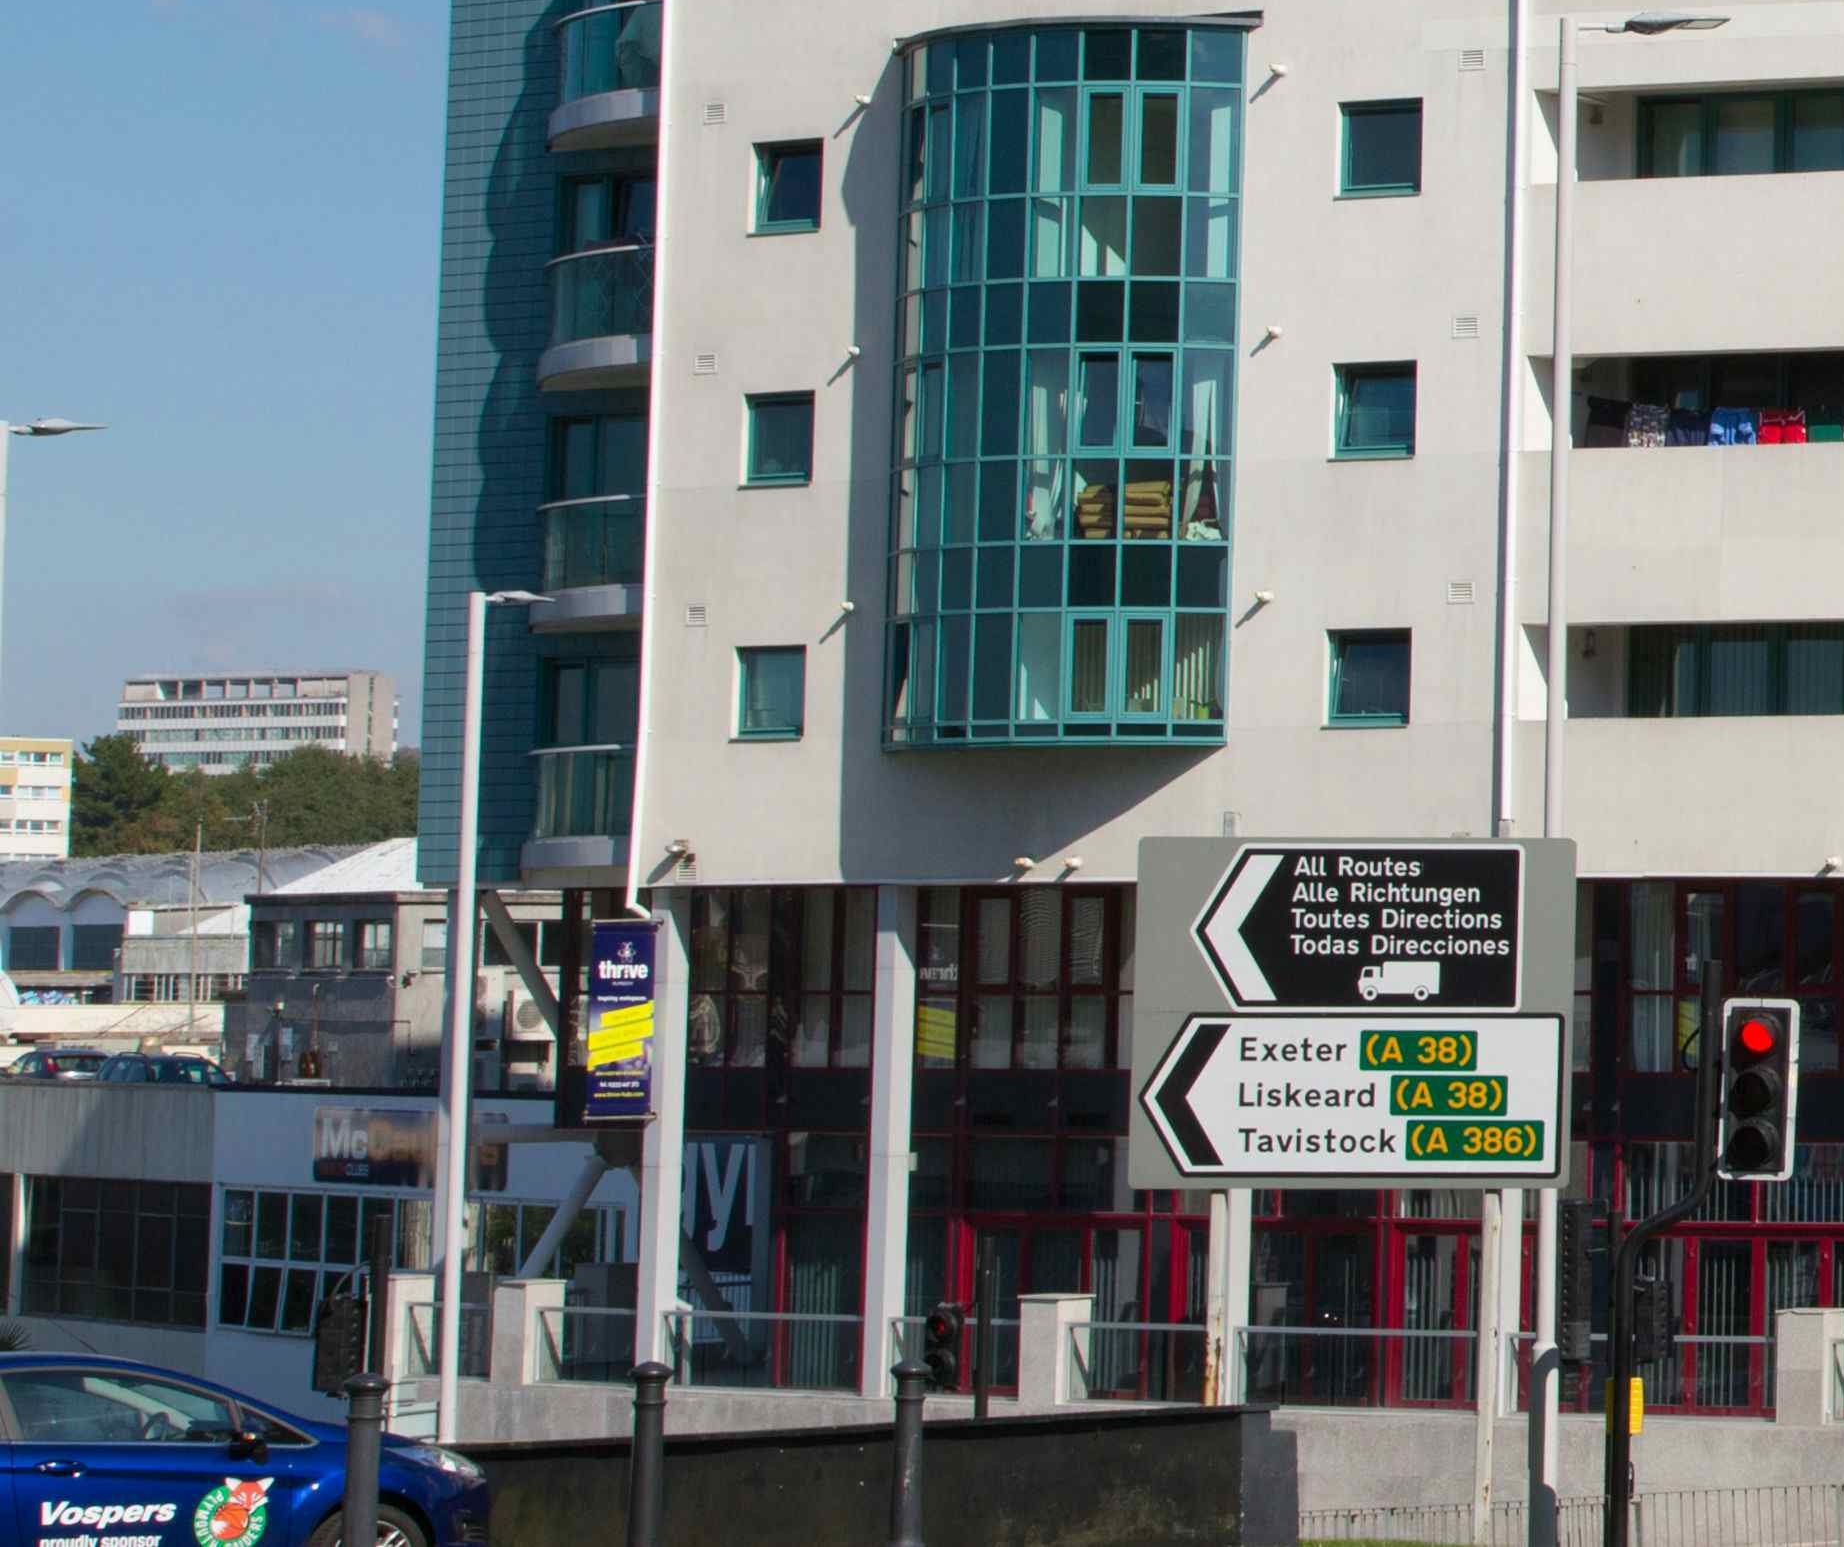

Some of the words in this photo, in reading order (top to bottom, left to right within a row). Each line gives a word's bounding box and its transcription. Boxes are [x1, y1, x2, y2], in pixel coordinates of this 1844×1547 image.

[1294, 856, 1327, 877] All
[1338, 856, 1421, 877] Routes
[1292, 882, 1339, 903] Alle
[1350, 882, 1481, 907] Richtungen
[1291, 908, 1370, 929] Toutes
[1381, 908, 1502, 929] Directions
[1290, 935, 1360, 956] Todas
[1371, 935, 1510, 956] Direcciones
[598, 960, 649, 979] thrive
[1240, 1037, 1347, 1062] Exeter
[1365, 1034, 1404, 1066] (A
[1417, 1034, 1473, 1066] 38)
[1238, 1082, 1376, 1107] Liskeard
[1395, 1078, 1434, 1111] (A
[1447, 1078, 1503, 1111] 38)
[1238, 1128, 1397, 1153] Tavistock
[1410, 1124, 1449, 1156] (A
[1462, 1124, 1537, 1156] 386)
[40, 1501, 177, 1529] Vospers
[102, 1535, 162, 1547] sponsor
